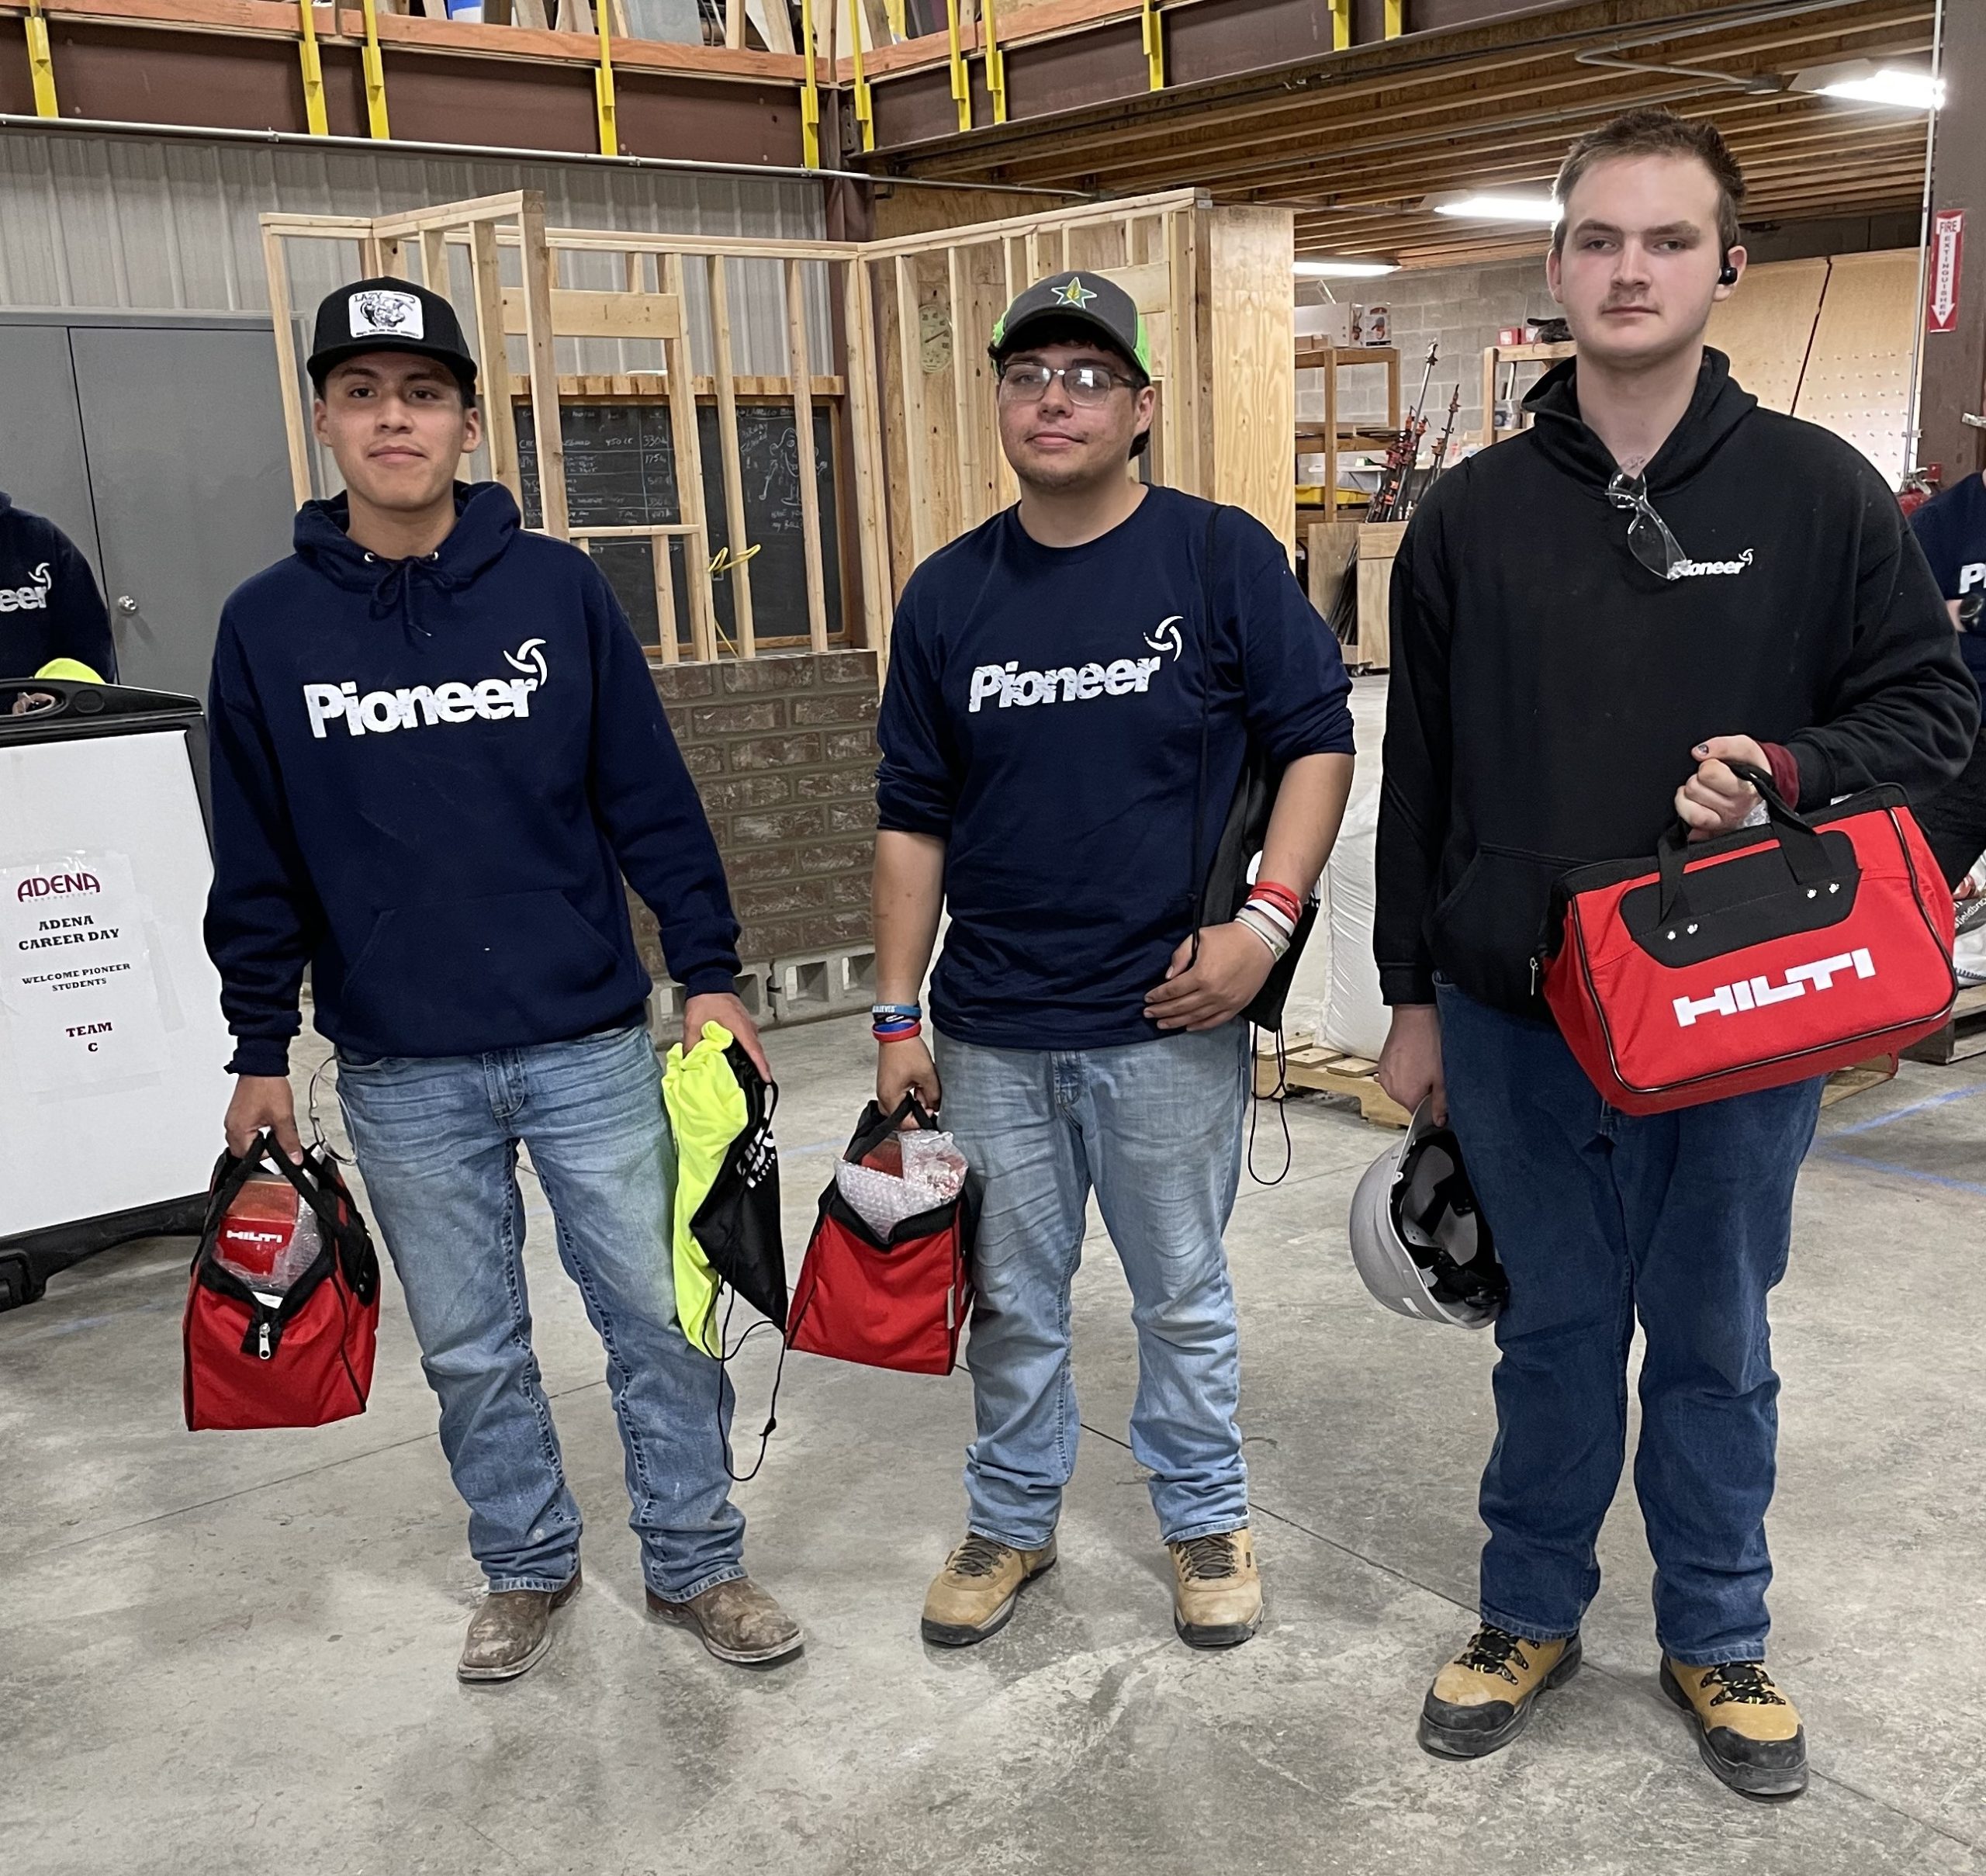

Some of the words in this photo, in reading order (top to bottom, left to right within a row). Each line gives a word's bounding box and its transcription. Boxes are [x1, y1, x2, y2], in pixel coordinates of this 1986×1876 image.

[1939, 220, 1957, 234] FIRE
[1939, 236, 1951, 316] EXTINGUISHER
[1959, 562, 1986, 594] P
[969, 656, 1161, 712] Pioneer
[303, 678, 538, 738] Pioneer
[17, 872, 101, 902] ADENA
[39, 915, 94, 931] ADENA
[19, 934, 85, 950] CAREER
[88, 928, 119, 943] DAY
[22, 970, 80, 985] WELCOME
[82, 963, 130, 977] PIONEER
[52, 978, 107, 992] STUDENTS
[1673, 947, 1876, 1027] HILTI
[66, 1022, 113, 1037] TEAM
[88, 1043, 99, 1052] C
[227, 1230, 282, 1243] HILTI
